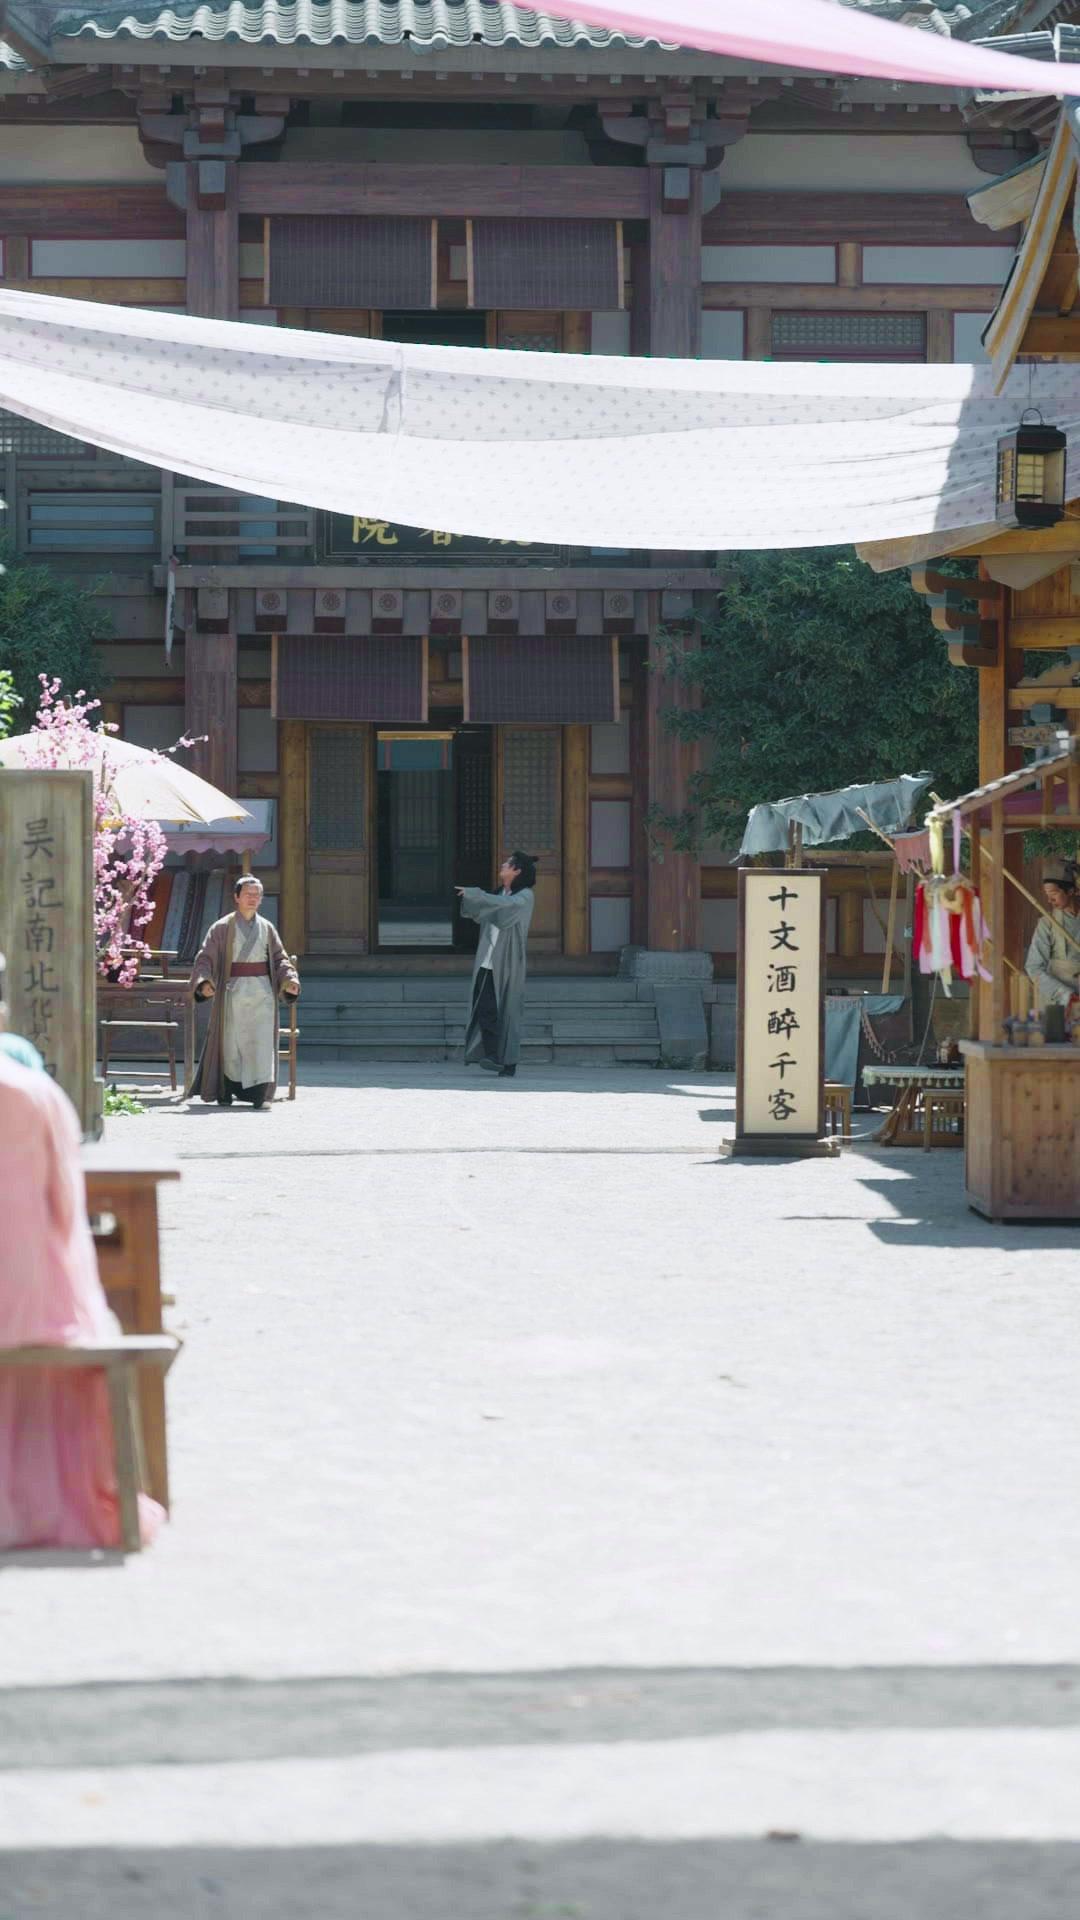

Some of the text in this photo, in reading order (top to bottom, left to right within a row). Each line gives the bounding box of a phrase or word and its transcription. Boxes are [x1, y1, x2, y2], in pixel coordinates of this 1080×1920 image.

[767, 886, 800, 1121] 十文酒醉千客
